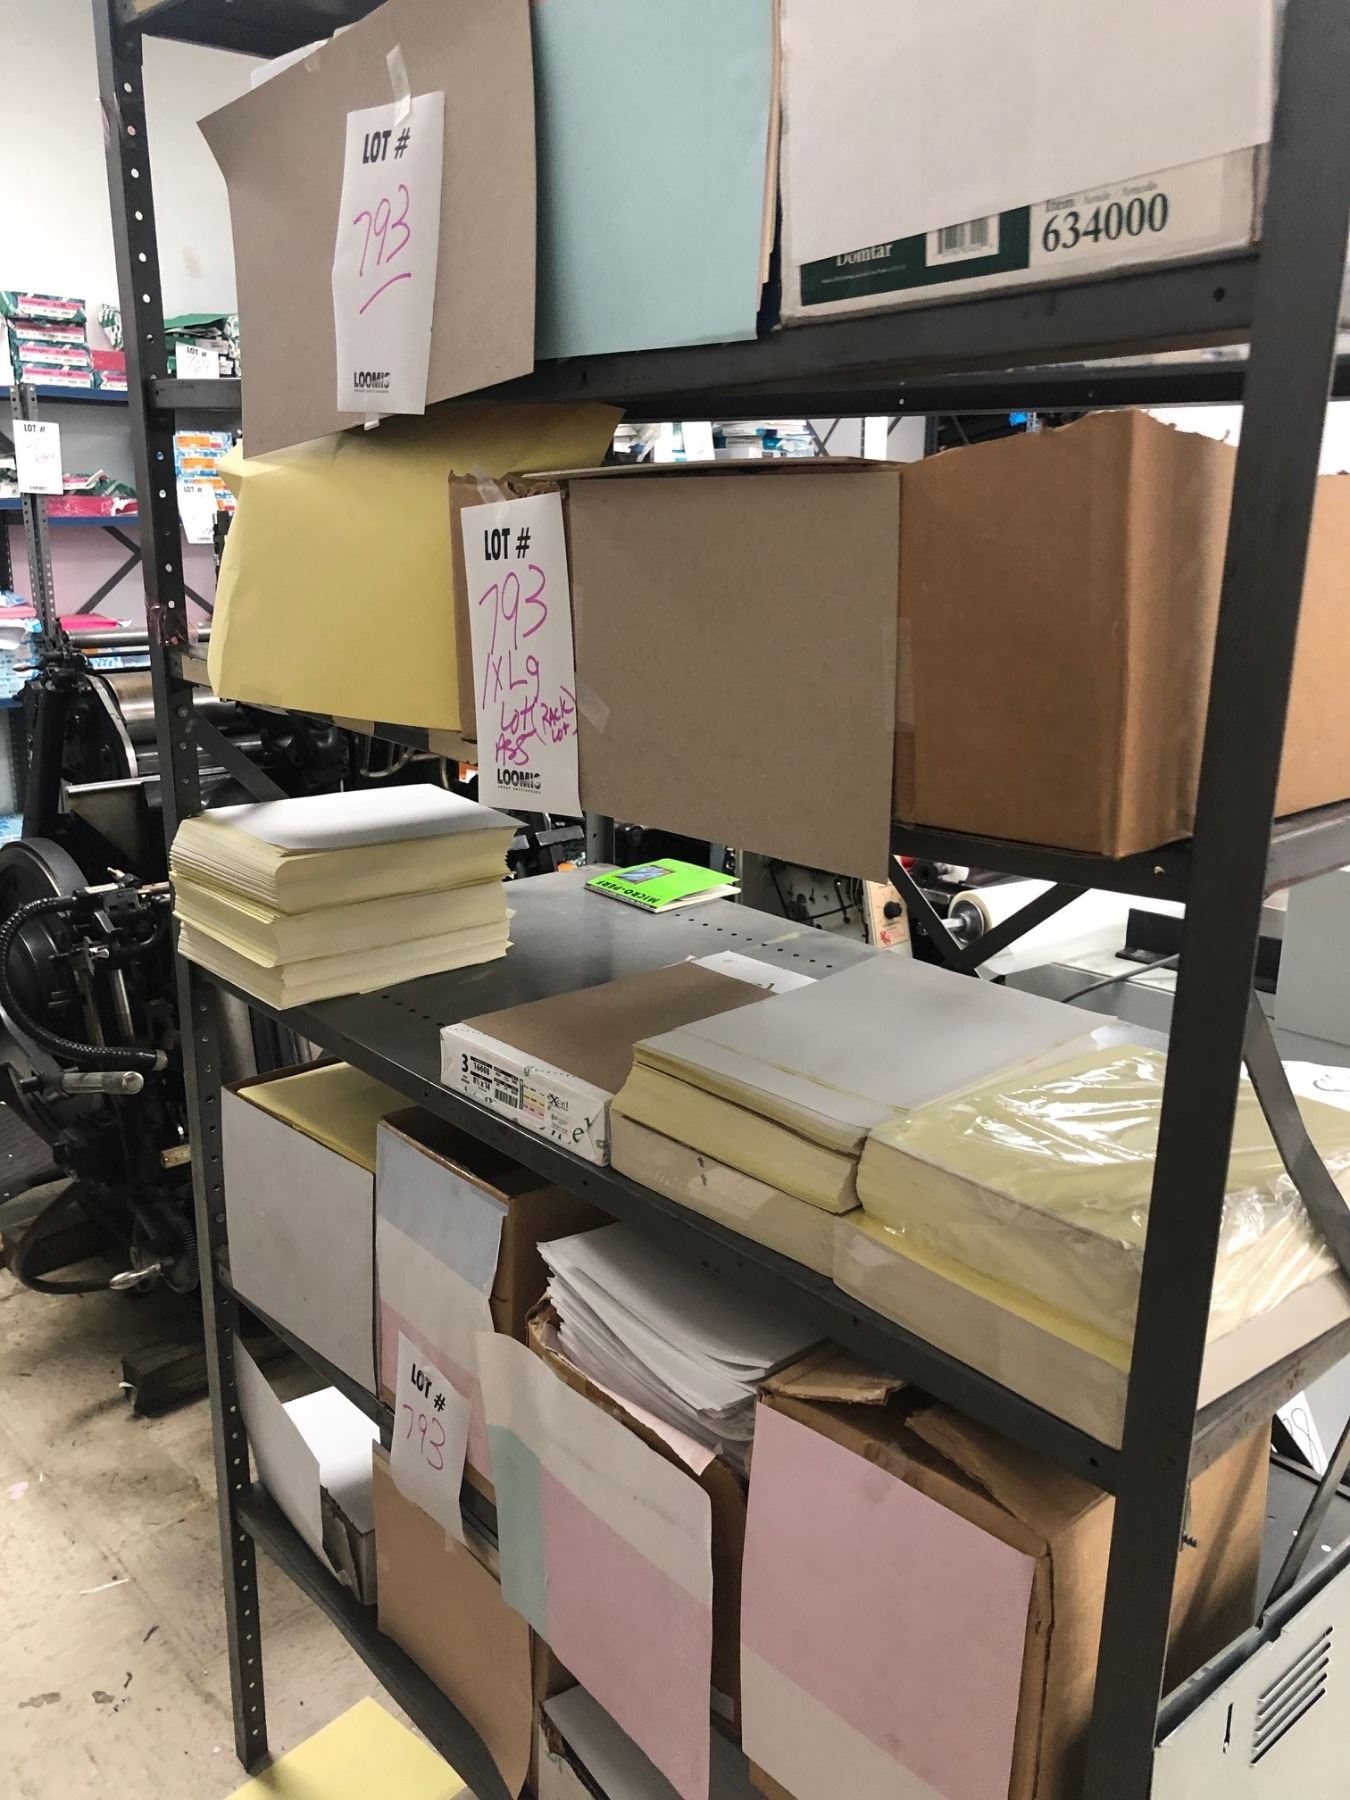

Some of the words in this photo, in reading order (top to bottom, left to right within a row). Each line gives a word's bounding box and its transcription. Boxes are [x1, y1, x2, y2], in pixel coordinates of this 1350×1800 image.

[362, 129, 392, 164] LOT
[394, 127, 411, 159] #
[353, 184, 412, 277] 793
[1042, 193, 1169, 253] 634000
[836, 243, 894, 267] Domtar
[354, 371, 391, 389] LOOMIS
[484, 528, 511, 561] LOT
[515, 527, 531, 559] #
[478, 564, 548, 655] 793
[496, 768, 542, 790] LOOMIS
[461, 1053, 469, 1073] 3
[410, 1363, 433, 1399] LOT
[433, 1393, 446, 1413] #
[403, 1404, 447, 1471] 793
